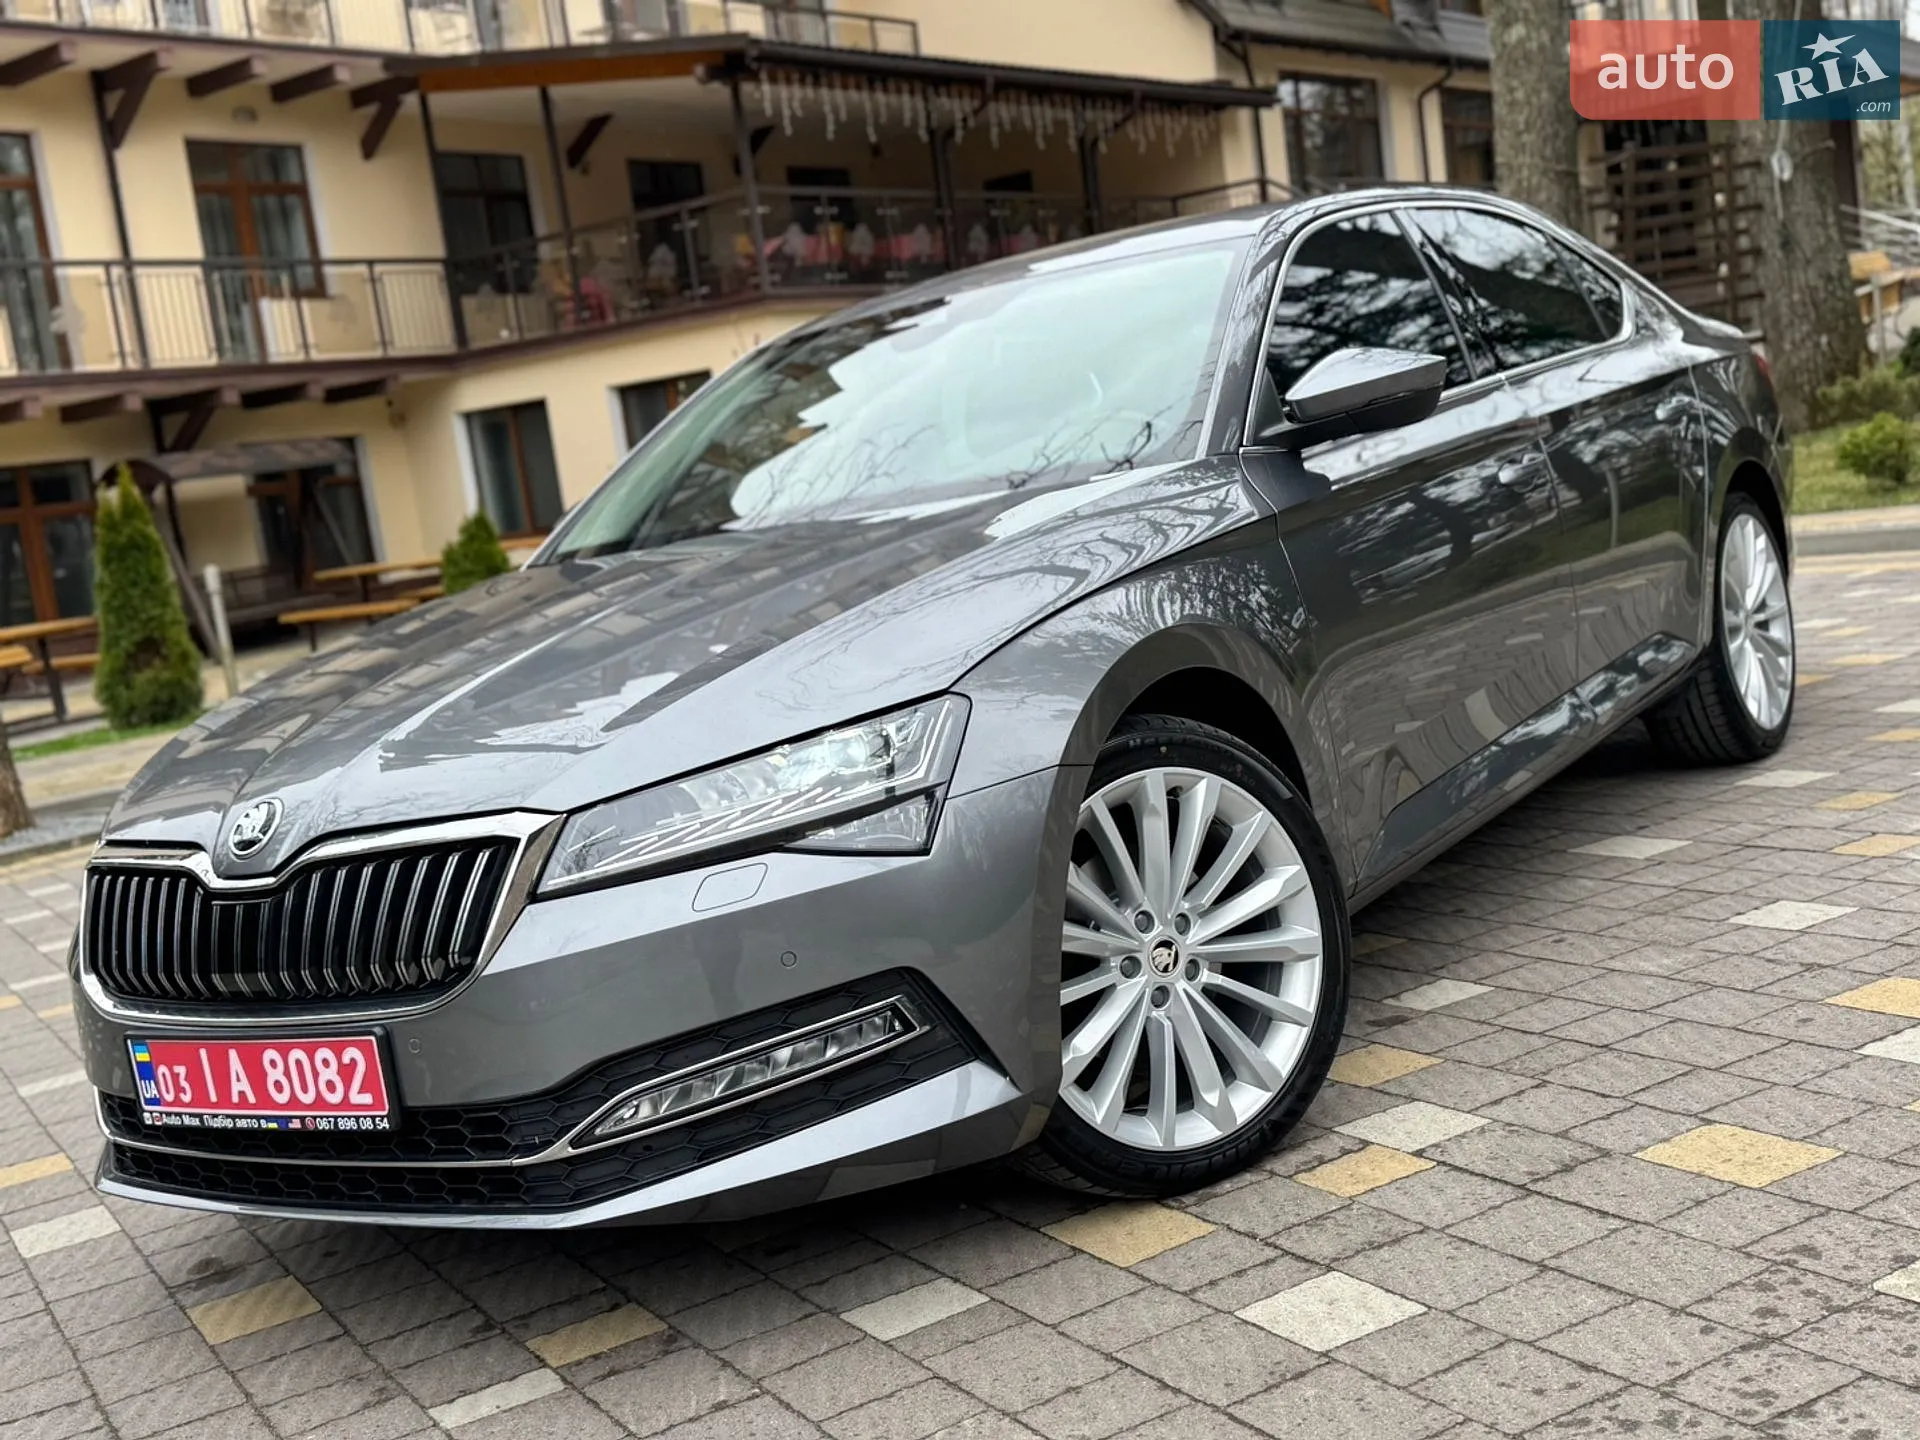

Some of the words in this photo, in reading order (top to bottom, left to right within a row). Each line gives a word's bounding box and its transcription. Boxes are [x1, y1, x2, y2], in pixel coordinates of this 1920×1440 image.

[157, 1064, 193, 1103] 03
[262, 1046, 373, 1105] 8082
[141, 1079, 160, 1099] UA
[316, 1117, 335, 1130] 067
[338, 1117, 357, 1130] 896
[360, 1117, 374, 1130] 08
[375, 1117, 390, 1130] 54
